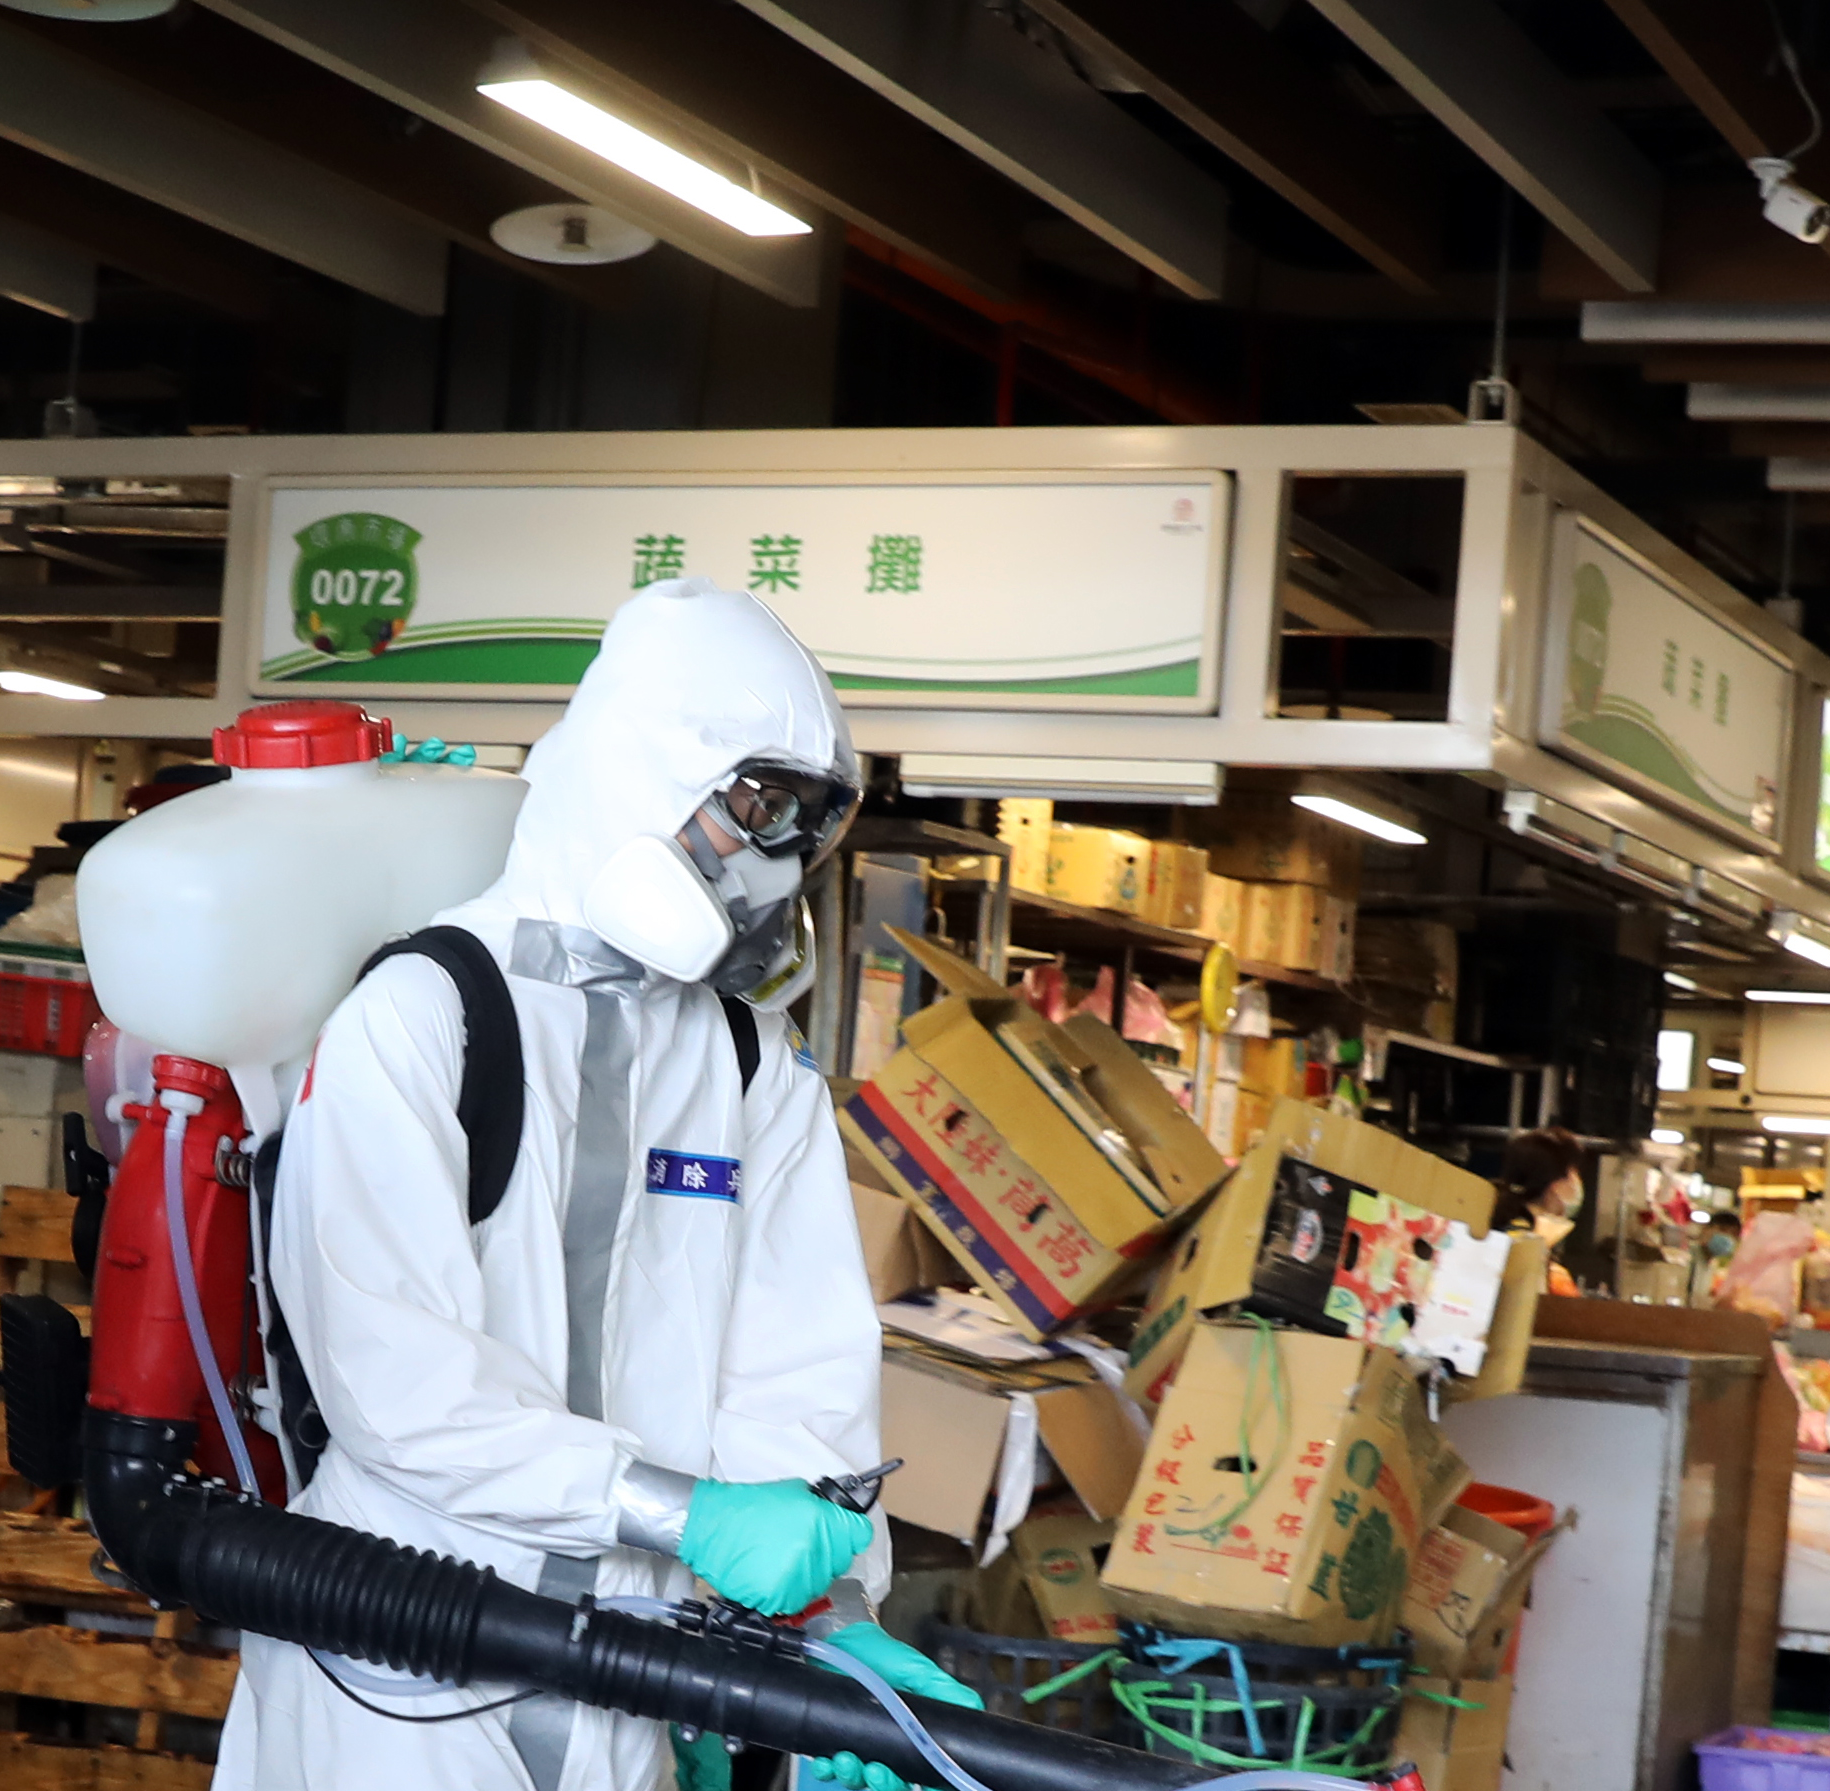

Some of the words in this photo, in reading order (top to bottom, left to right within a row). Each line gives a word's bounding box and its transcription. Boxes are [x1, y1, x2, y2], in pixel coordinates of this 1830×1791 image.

[309, 567, 406, 607] 0072
[630, 534, 923, 594] 蔬菜攤
